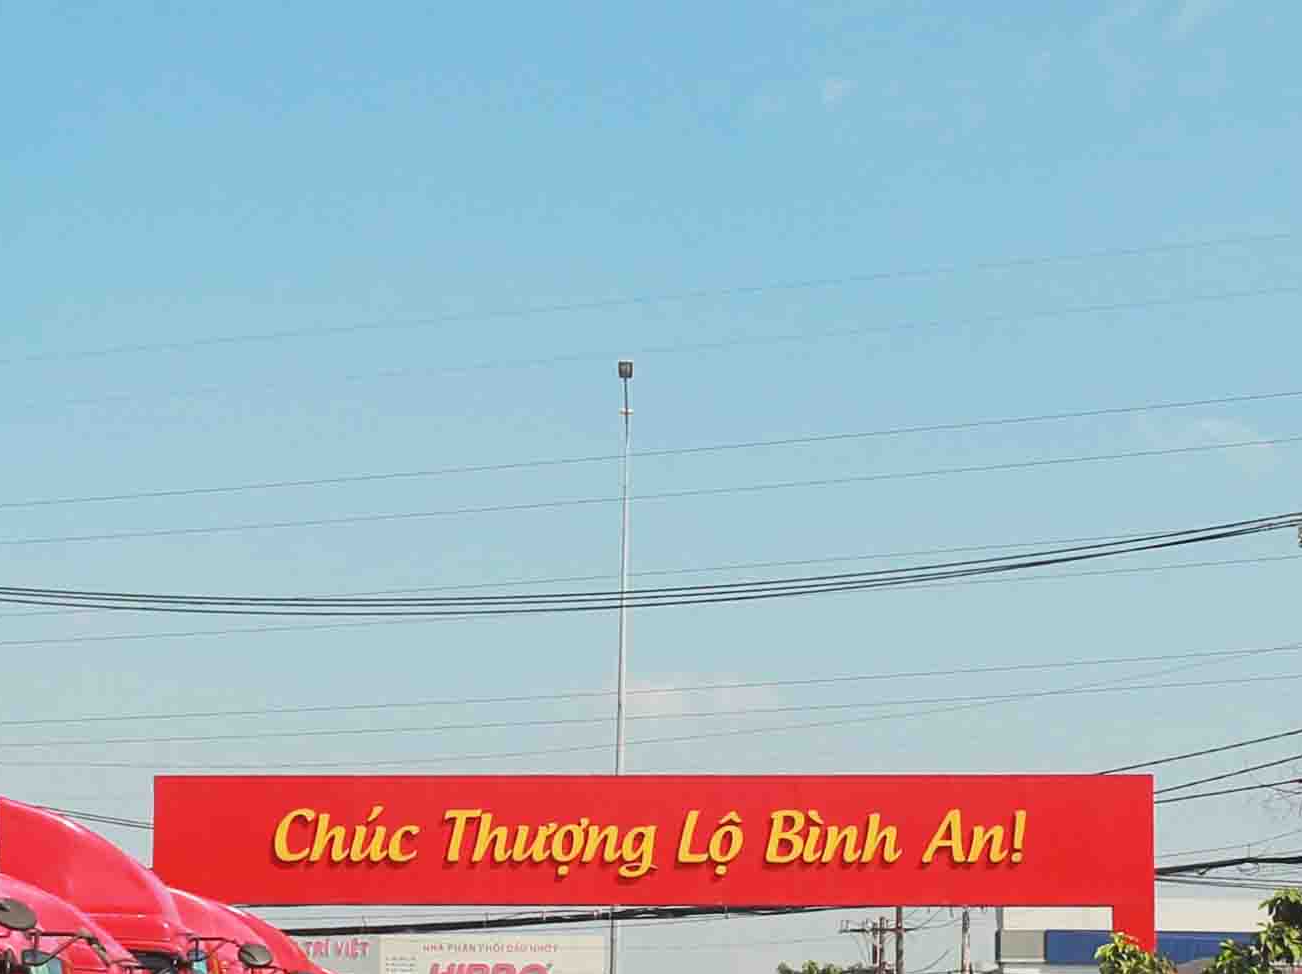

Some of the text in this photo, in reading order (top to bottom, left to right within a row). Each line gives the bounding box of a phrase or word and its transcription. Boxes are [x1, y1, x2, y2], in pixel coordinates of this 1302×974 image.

[273, 804, 1027, 879] Chúc Thượng Lộ Bình An!
